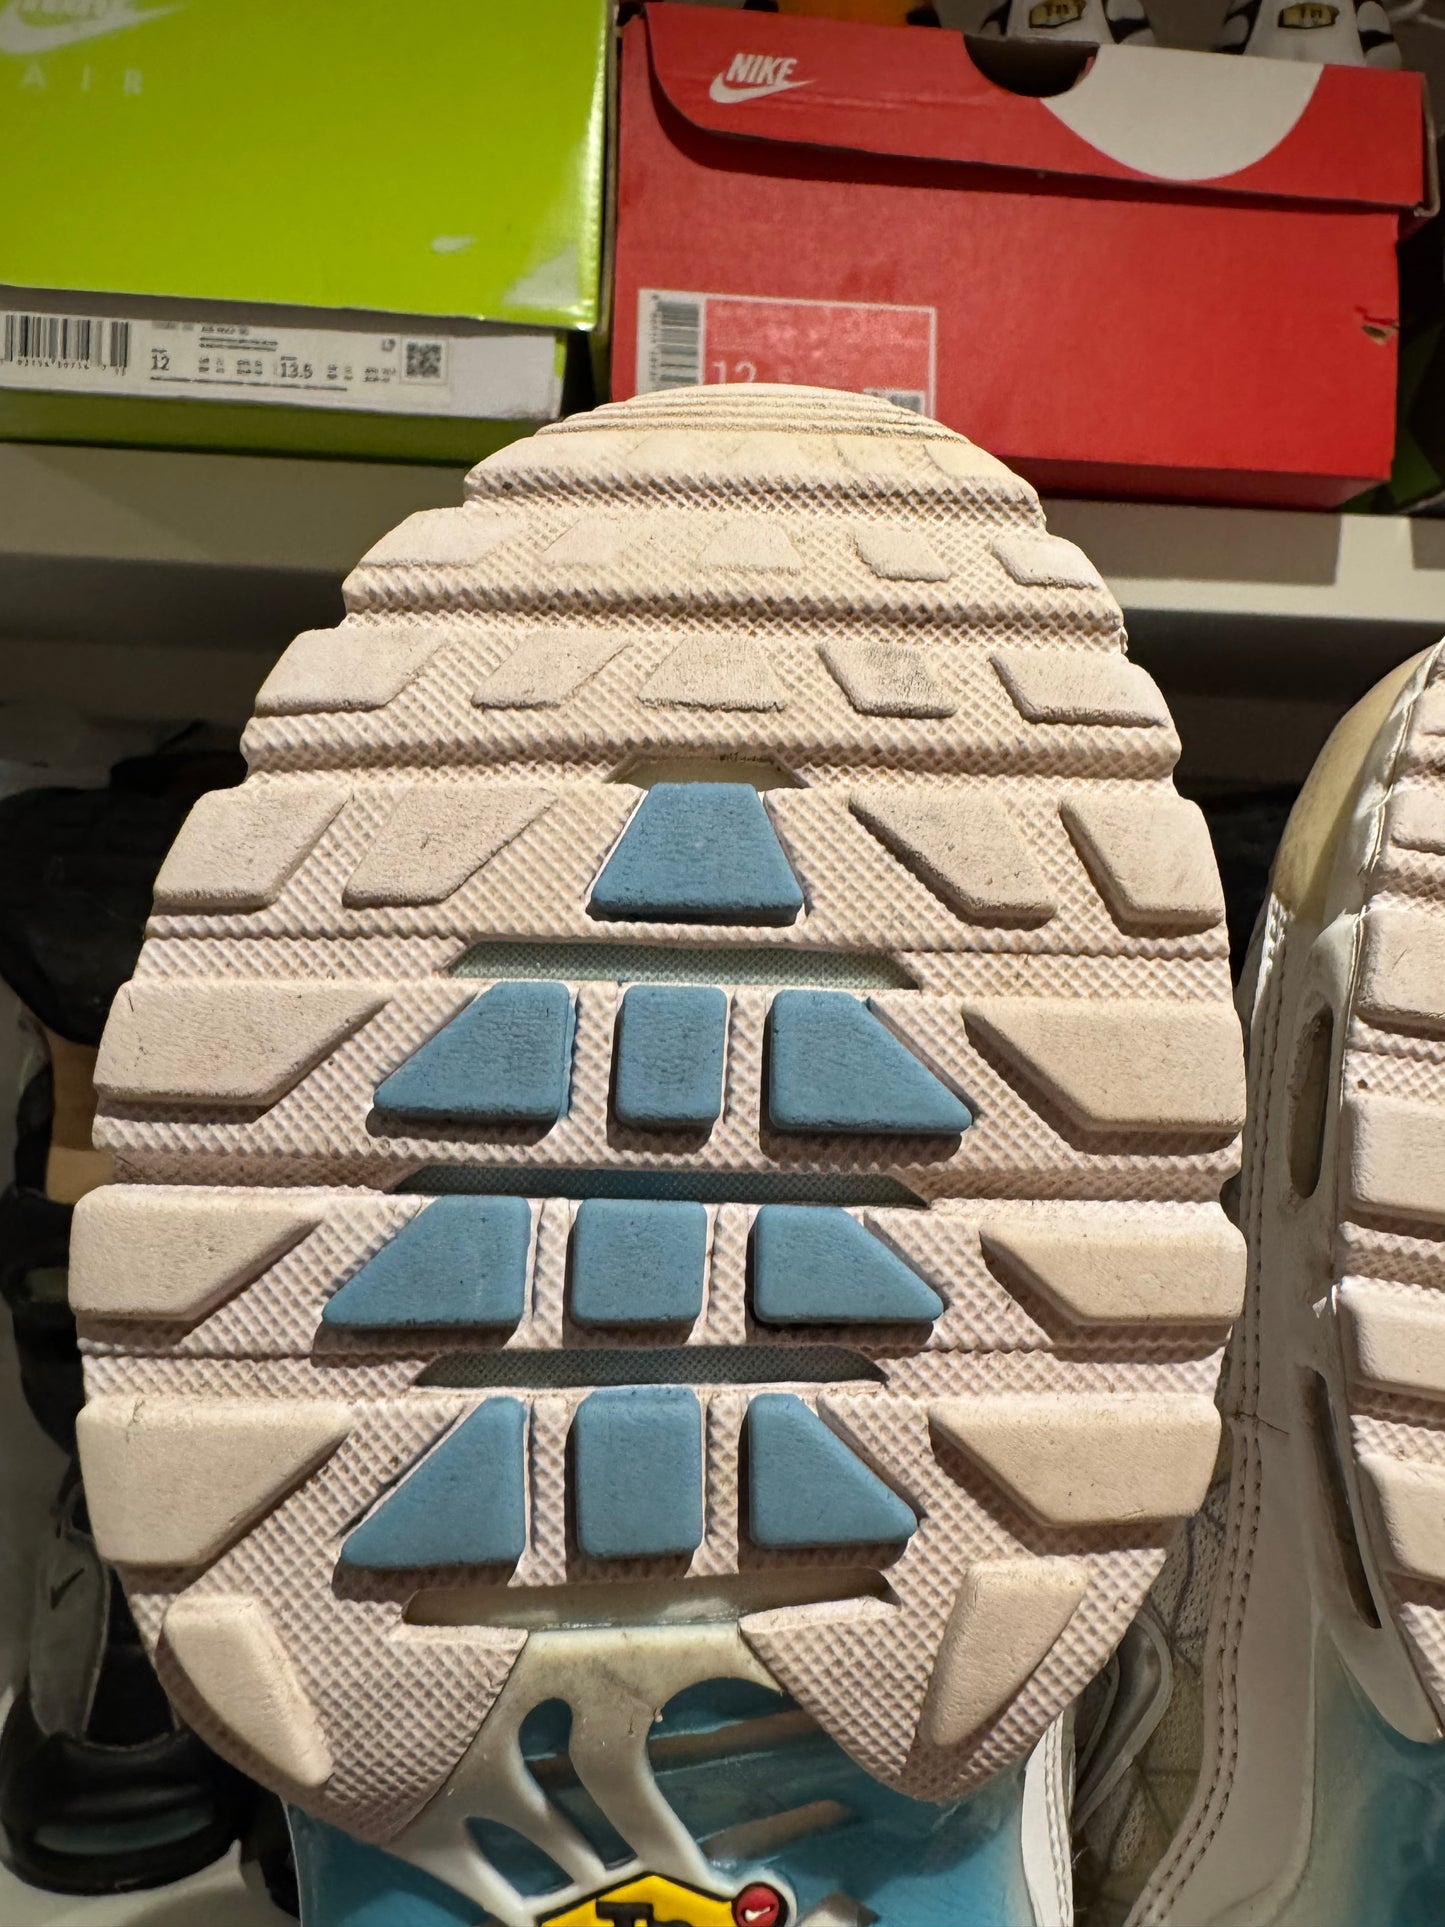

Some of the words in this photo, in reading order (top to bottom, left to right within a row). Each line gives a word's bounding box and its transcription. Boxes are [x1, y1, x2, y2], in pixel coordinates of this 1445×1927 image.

[20, 63, 143, 96] AIR
[726, 52, 798, 85] NIKE
[151, 354, 170, 371] 12
[280, 361, 314, 380] 13.5
